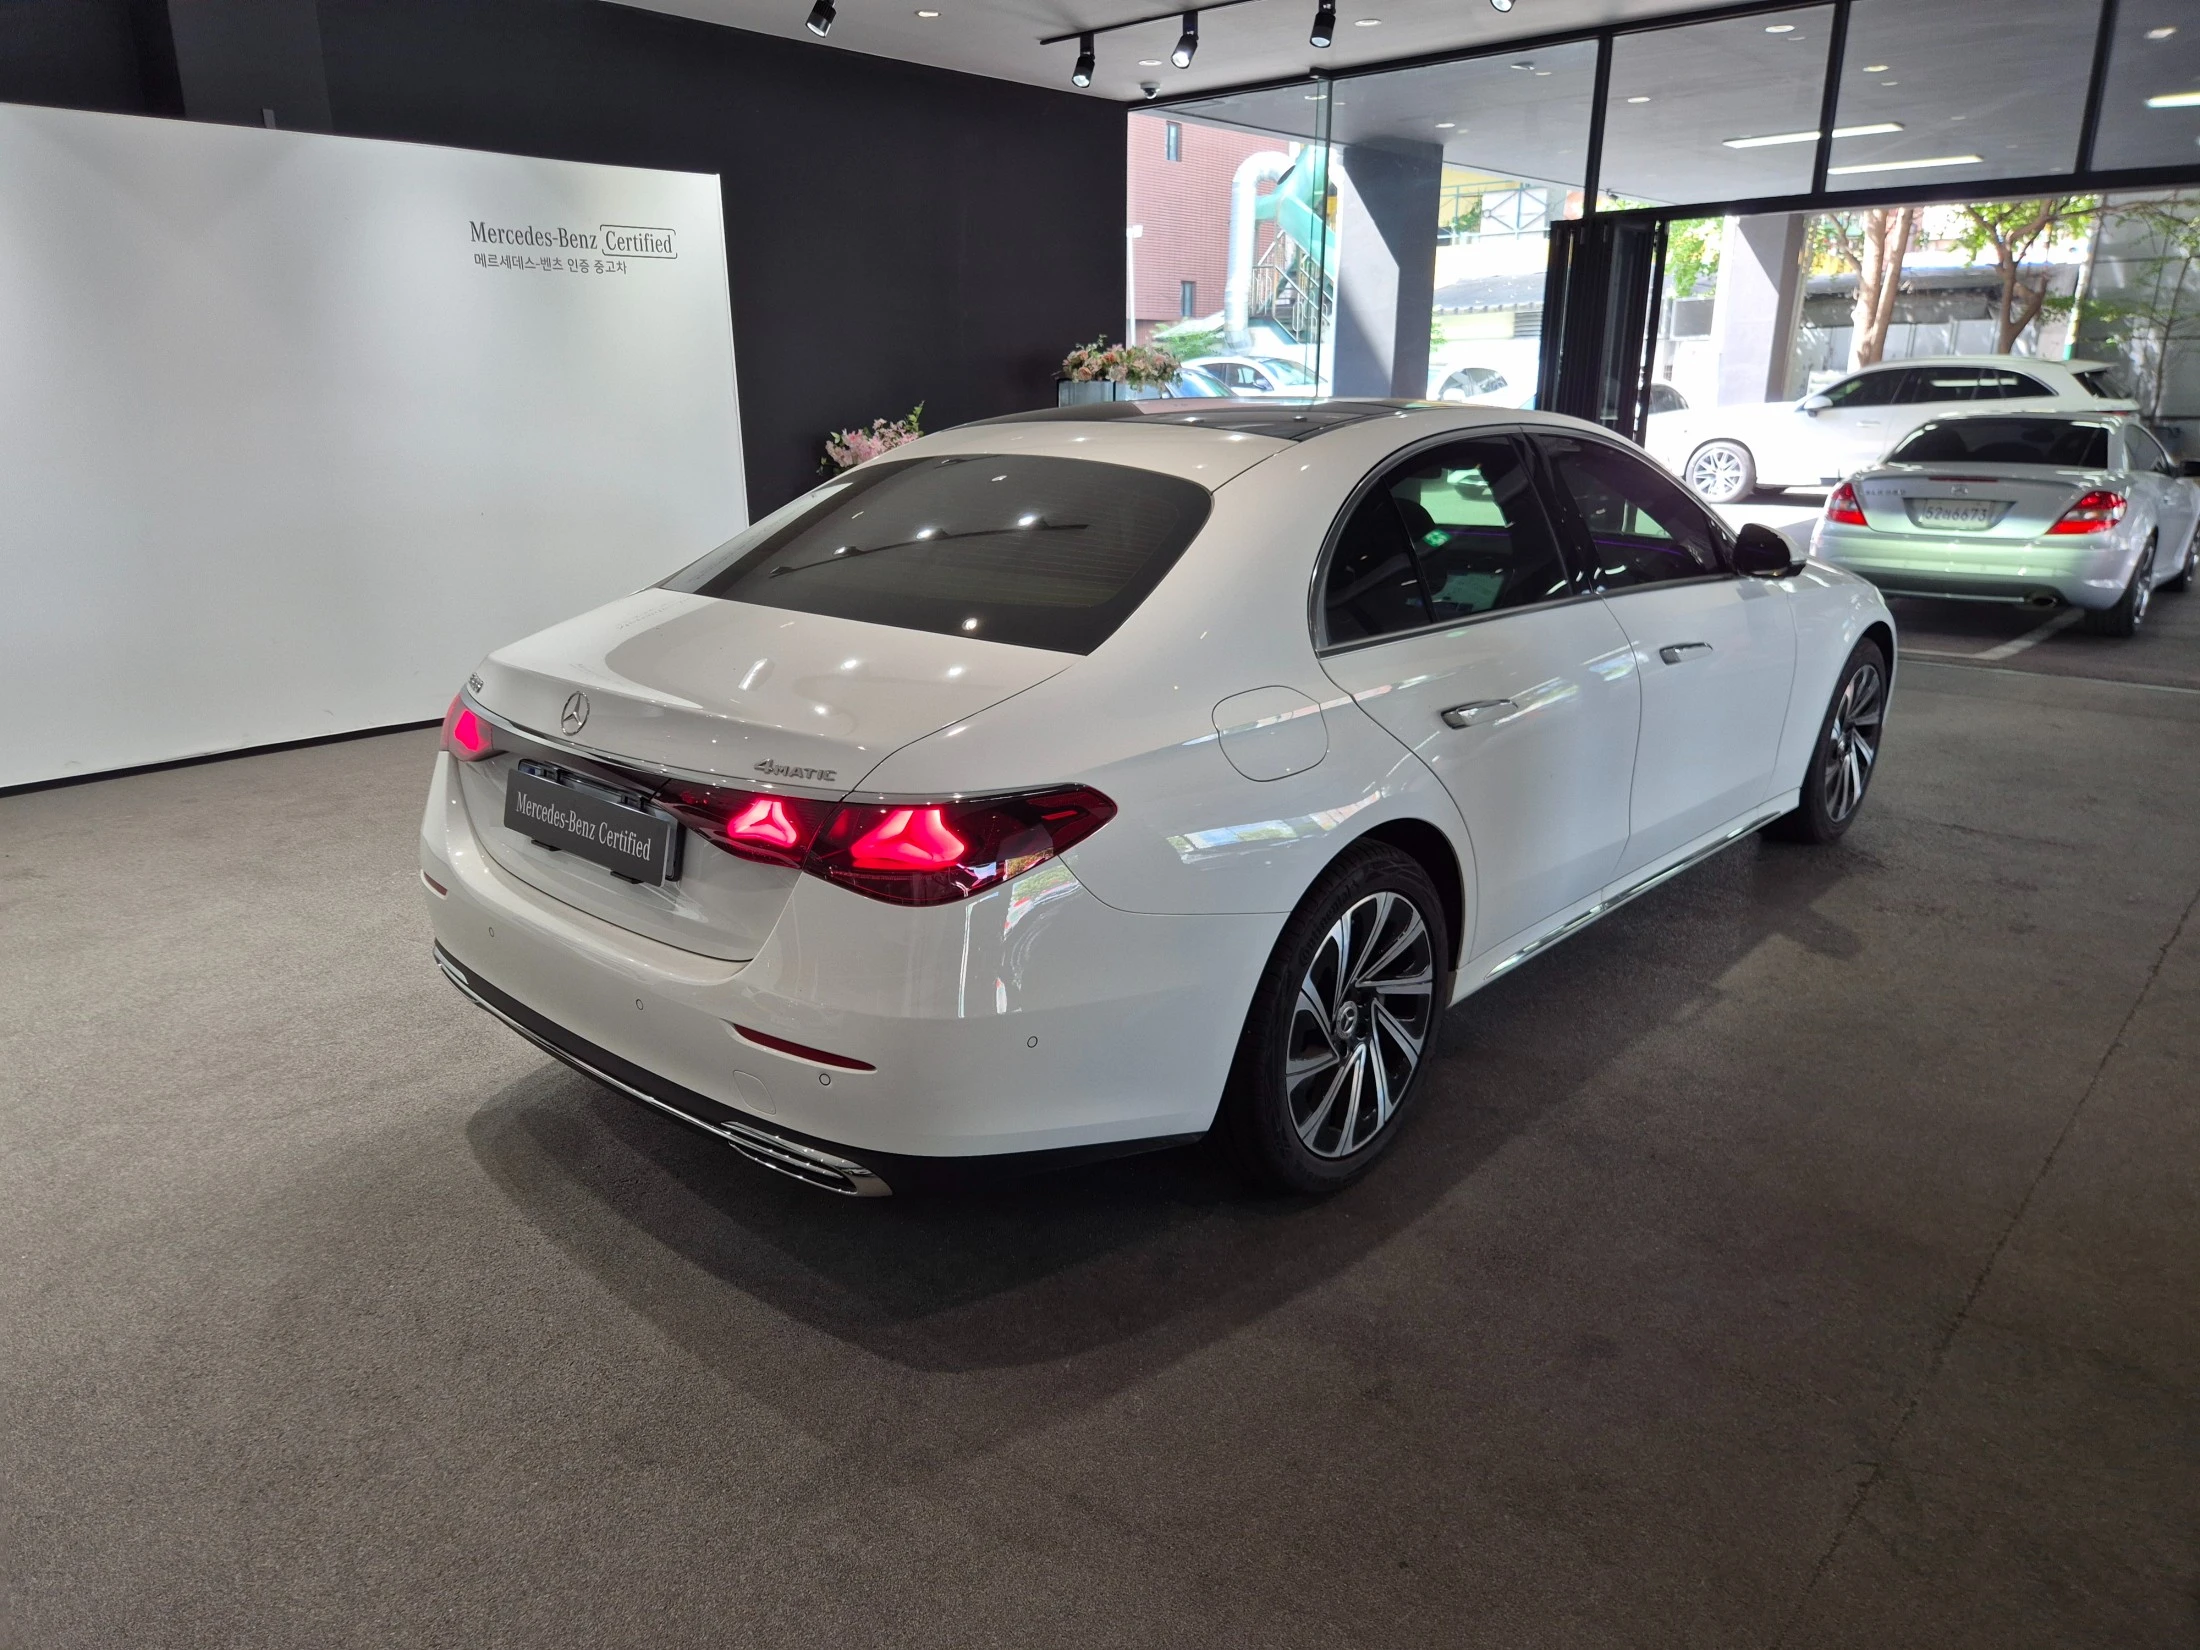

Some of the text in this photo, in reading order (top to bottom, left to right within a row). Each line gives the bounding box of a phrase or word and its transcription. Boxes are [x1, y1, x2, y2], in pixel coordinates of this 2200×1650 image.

[469, 221, 673, 253] Mercedes-Benz Certified
[474, 253, 627, 275] 메르세데스-벤츠 인증 중고차
[754, 758, 837, 781] 4MATIC
[516, 791, 651, 861] Mercedes-Benz Certified
